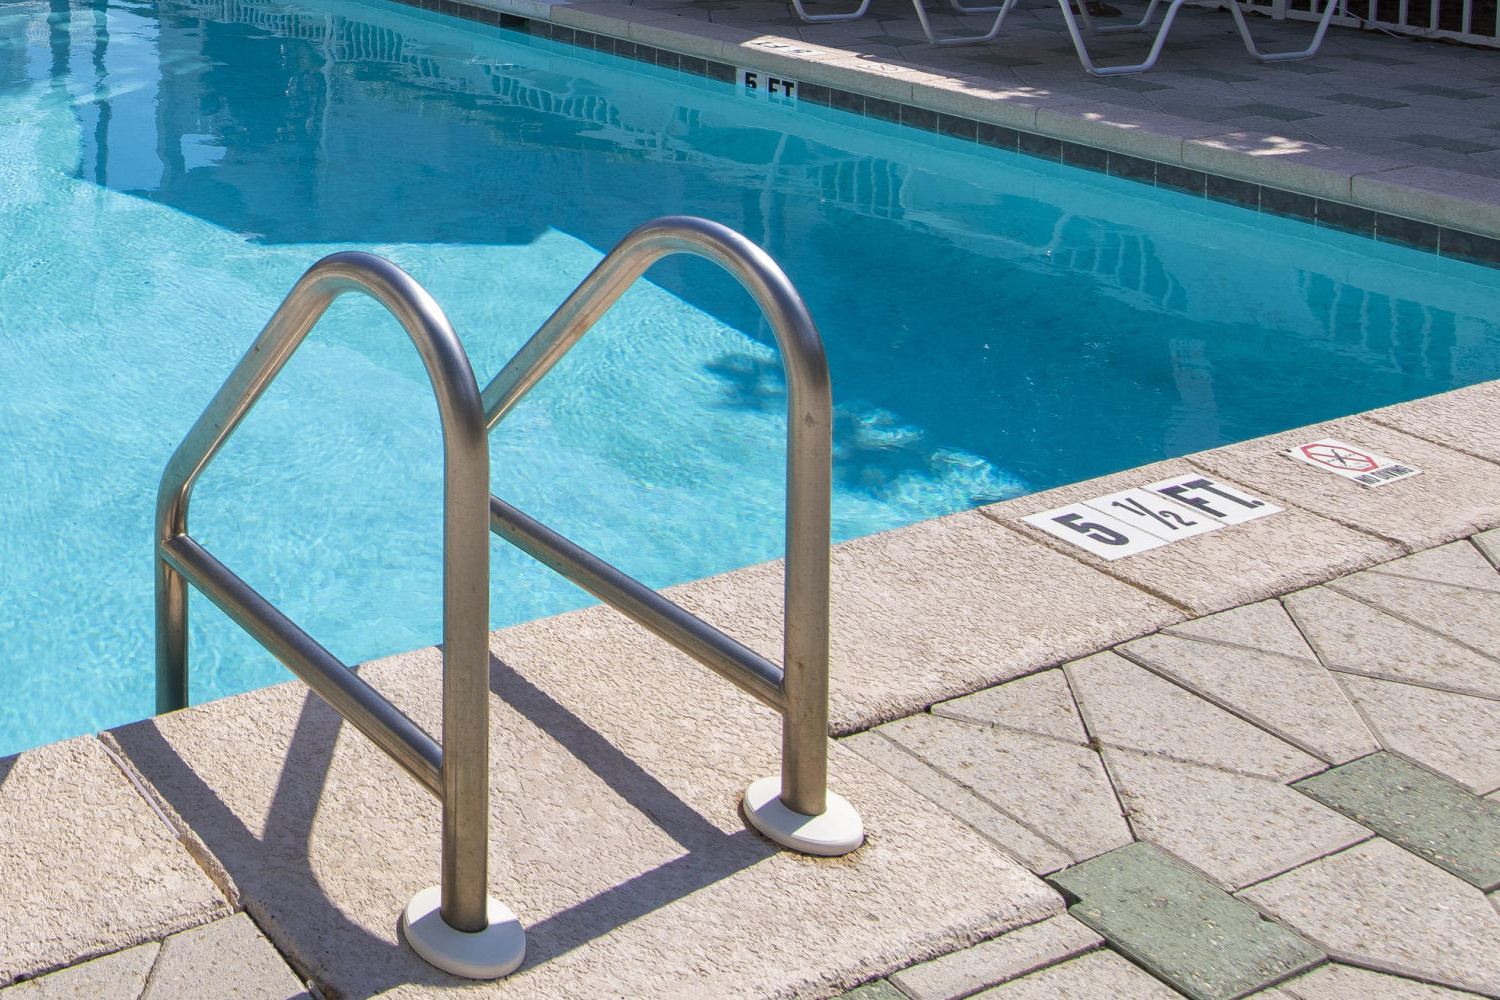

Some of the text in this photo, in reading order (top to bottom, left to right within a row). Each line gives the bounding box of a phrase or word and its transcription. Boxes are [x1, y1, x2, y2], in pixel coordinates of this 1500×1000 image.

[745, 71, 758, 89] 5
[1354, 474, 1381, 485] NO
[1051, 512, 1130, 546] 5
